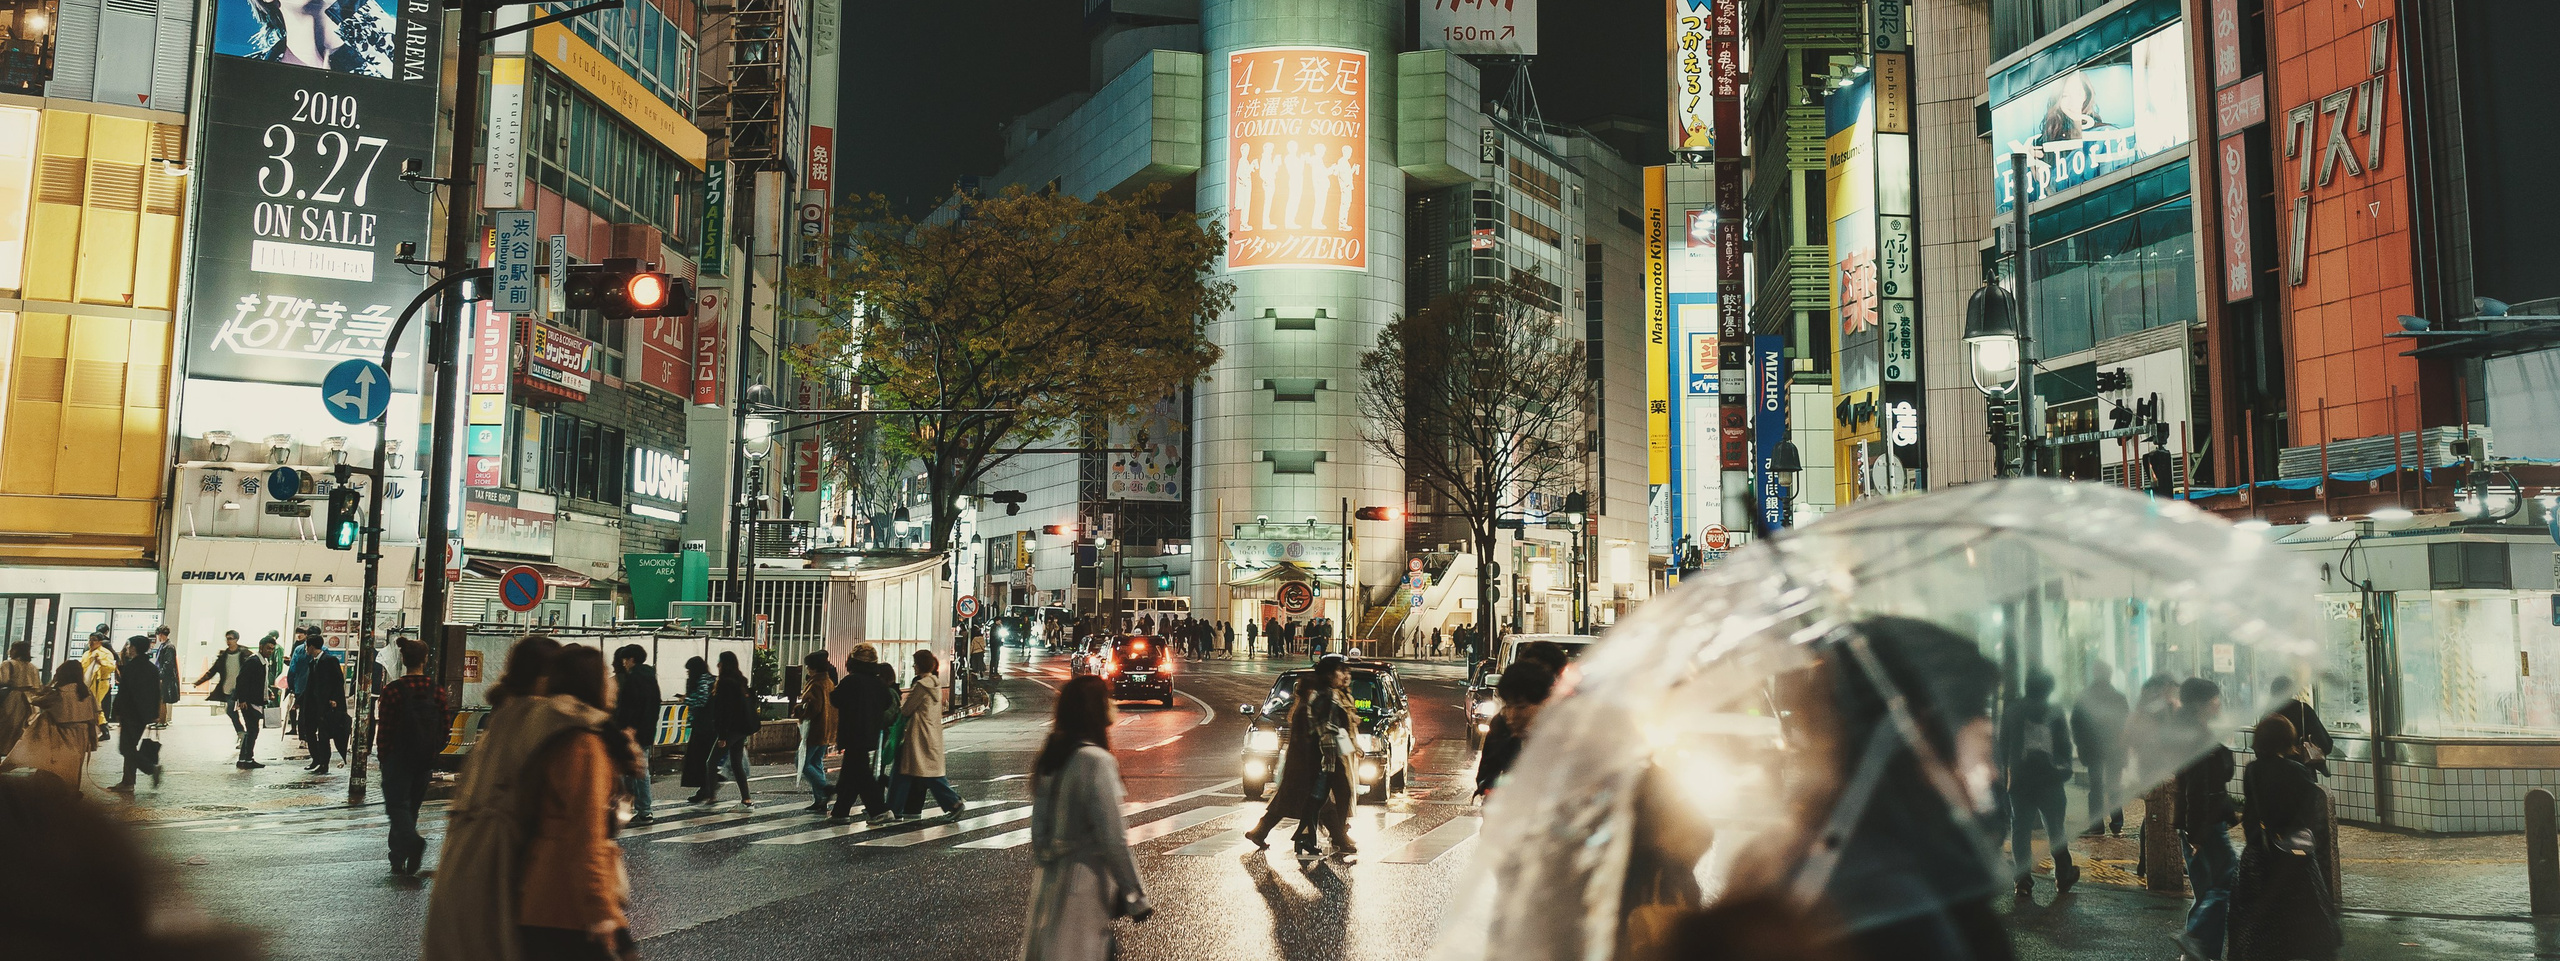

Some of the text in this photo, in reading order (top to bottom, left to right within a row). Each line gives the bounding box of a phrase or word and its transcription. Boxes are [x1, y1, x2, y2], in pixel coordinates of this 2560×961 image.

[403, 19, 427, 81] ARENA
[573, 52, 607, 85] studio
[644, 106, 657, 121] new
[660, 116, 675, 135] york
[1235, 56, 1361, 96] 4.1 発足
[1886, 58, 1896, 119] Euphoria
[292, 89, 361, 129] 2019.
[1235, 97, 1361, 119] #洗濯愛してる会
[2219, 92, 2234, 105] 渋谷
[509, 93, 520, 145] studio
[1234, 119, 1361, 139] COMING SOON!
[258, 124, 389, 207] 3.27
[492, 146, 502, 173] york
[812, 145, 828, 181] 免税
[253, 201, 377, 247] ON SALE
[2226, 145, 2249, 292] もんじゃ焼
[498, 232, 511, 293] Shibuya Sta.
[510, 219, 530, 304] 渋谷駅前
[552, 239, 563, 308] スクランブル
[1884, 239, 1896, 279] パーラー
[1898, 233, 1908, 274] フルーツ
[1650, 208, 1663, 344] Matsumoto KiYoshi
[1840, 246, 1878, 334] 薬
[1886, 284, 1896, 292] 2F
[481, 302, 500, 382] ドラッグ
[535, 328, 546, 356] 薬
[546, 342, 581, 371] サンドラッグ
[1887, 322, 1898, 363] フルーツ
[1900, 316, 1911, 360] 渋谷西村
[533, 363, 541, 373] TAX
[541, 366, 551, 377] FREE
[661, 360, 673, 383] 3F
[699, 336, 716, 381] アコム
[1765, 351, 1779, 412] MIZUHO
[483, 401, 492, 409] 3F
[1651, 400, 1666, 414] 薬
[201, 474, 404, 499] 渋谷前ビル
[634, 447, 684, 503] LUSH
[475, 489, 511, 504] TAX FREE SHOP
[181, 571, 334, 583] SHIBUYA EKIMAE A
[639, 558, 676, 567] SMOKING
[656, 567, 675, 575] AREA
[305, 593, 341, 602] SHIBUYA
[343, 594, 362, 602] EKIM
